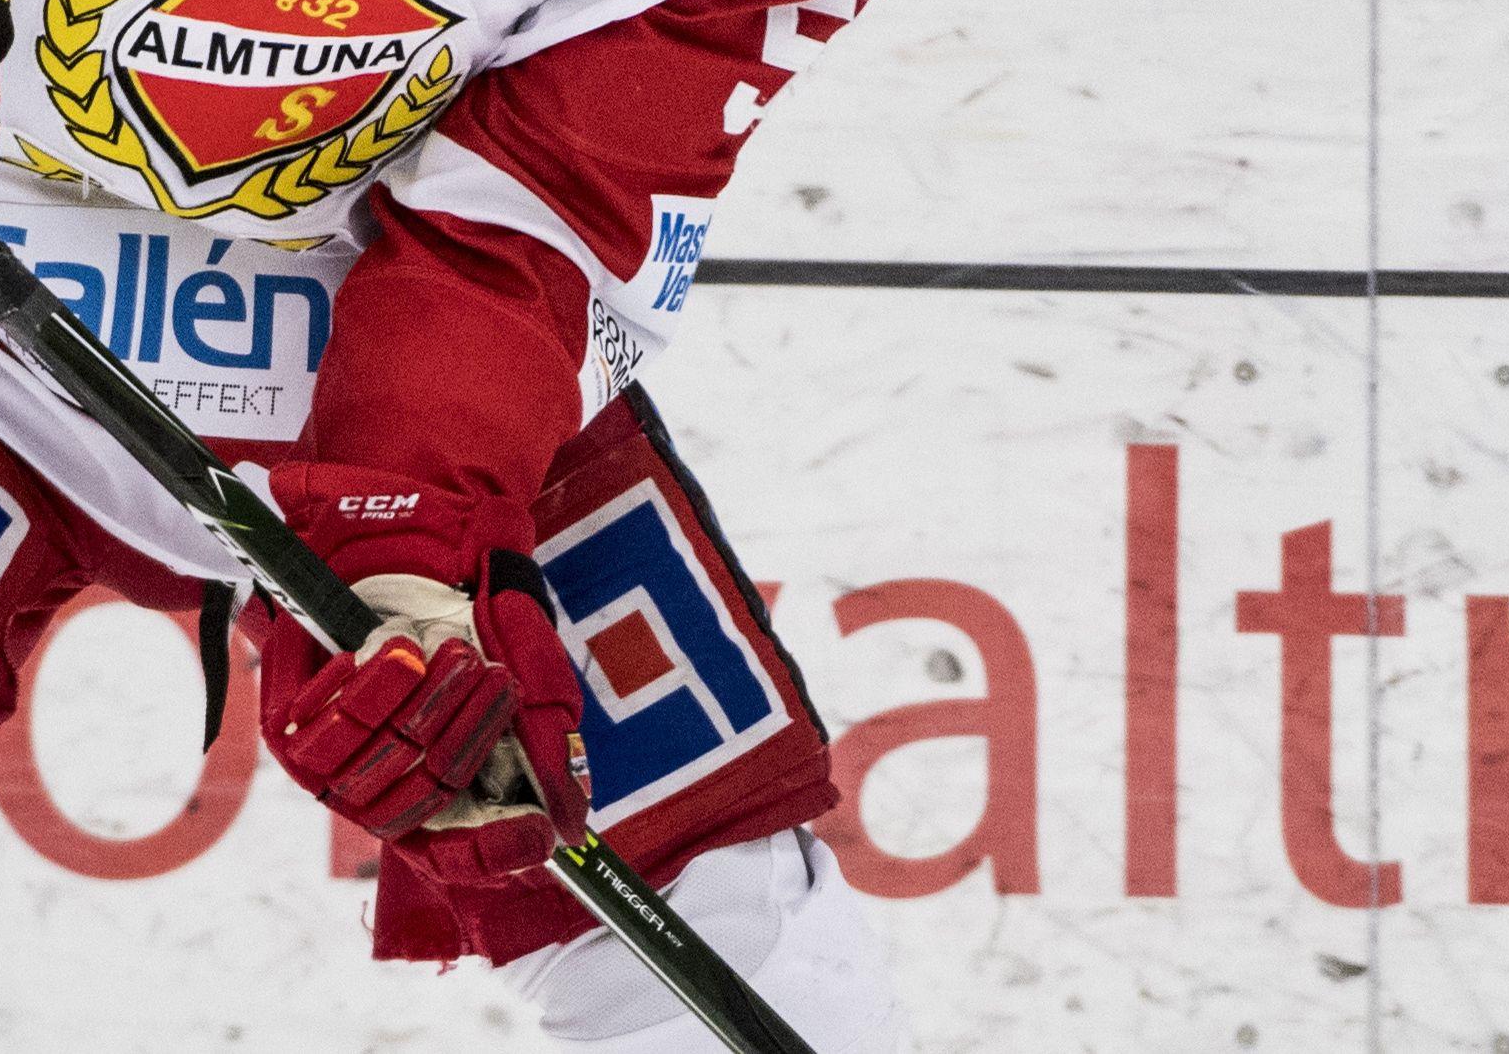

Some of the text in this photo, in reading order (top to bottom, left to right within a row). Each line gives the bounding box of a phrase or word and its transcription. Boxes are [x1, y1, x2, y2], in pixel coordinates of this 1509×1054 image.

[127, 20, 408, 78] ALMTUNA
[254, 85, 337, 143] S
[653, 211, 712, 263] Mas
[592, 297, 644, 370] GOLV
[338, 492, 420, 513] CCM
[595, 857, 665, 932] TRIGGER
